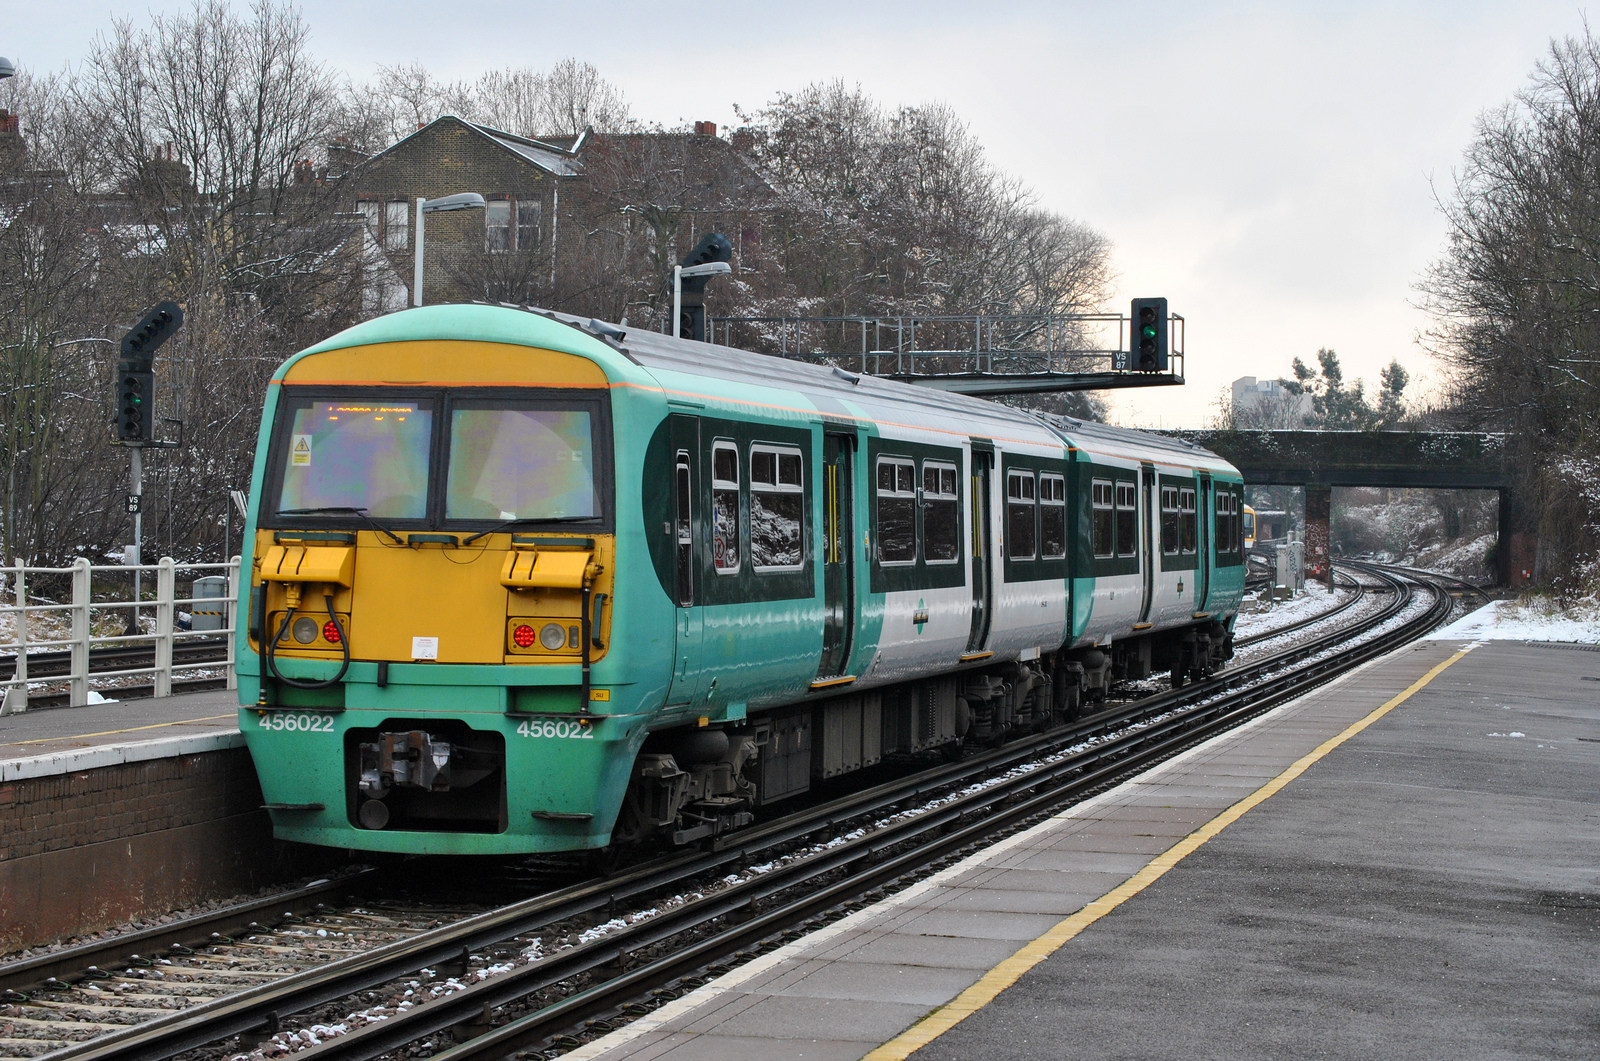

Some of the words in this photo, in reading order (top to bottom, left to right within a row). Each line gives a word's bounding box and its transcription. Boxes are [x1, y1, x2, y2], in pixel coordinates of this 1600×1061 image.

[1115, 352, 1126, 360] VS
[1115, 361, 1126, 369] 87
[259, 714, 335, 732] 456022
[516, 720, 594, 739] 456022
